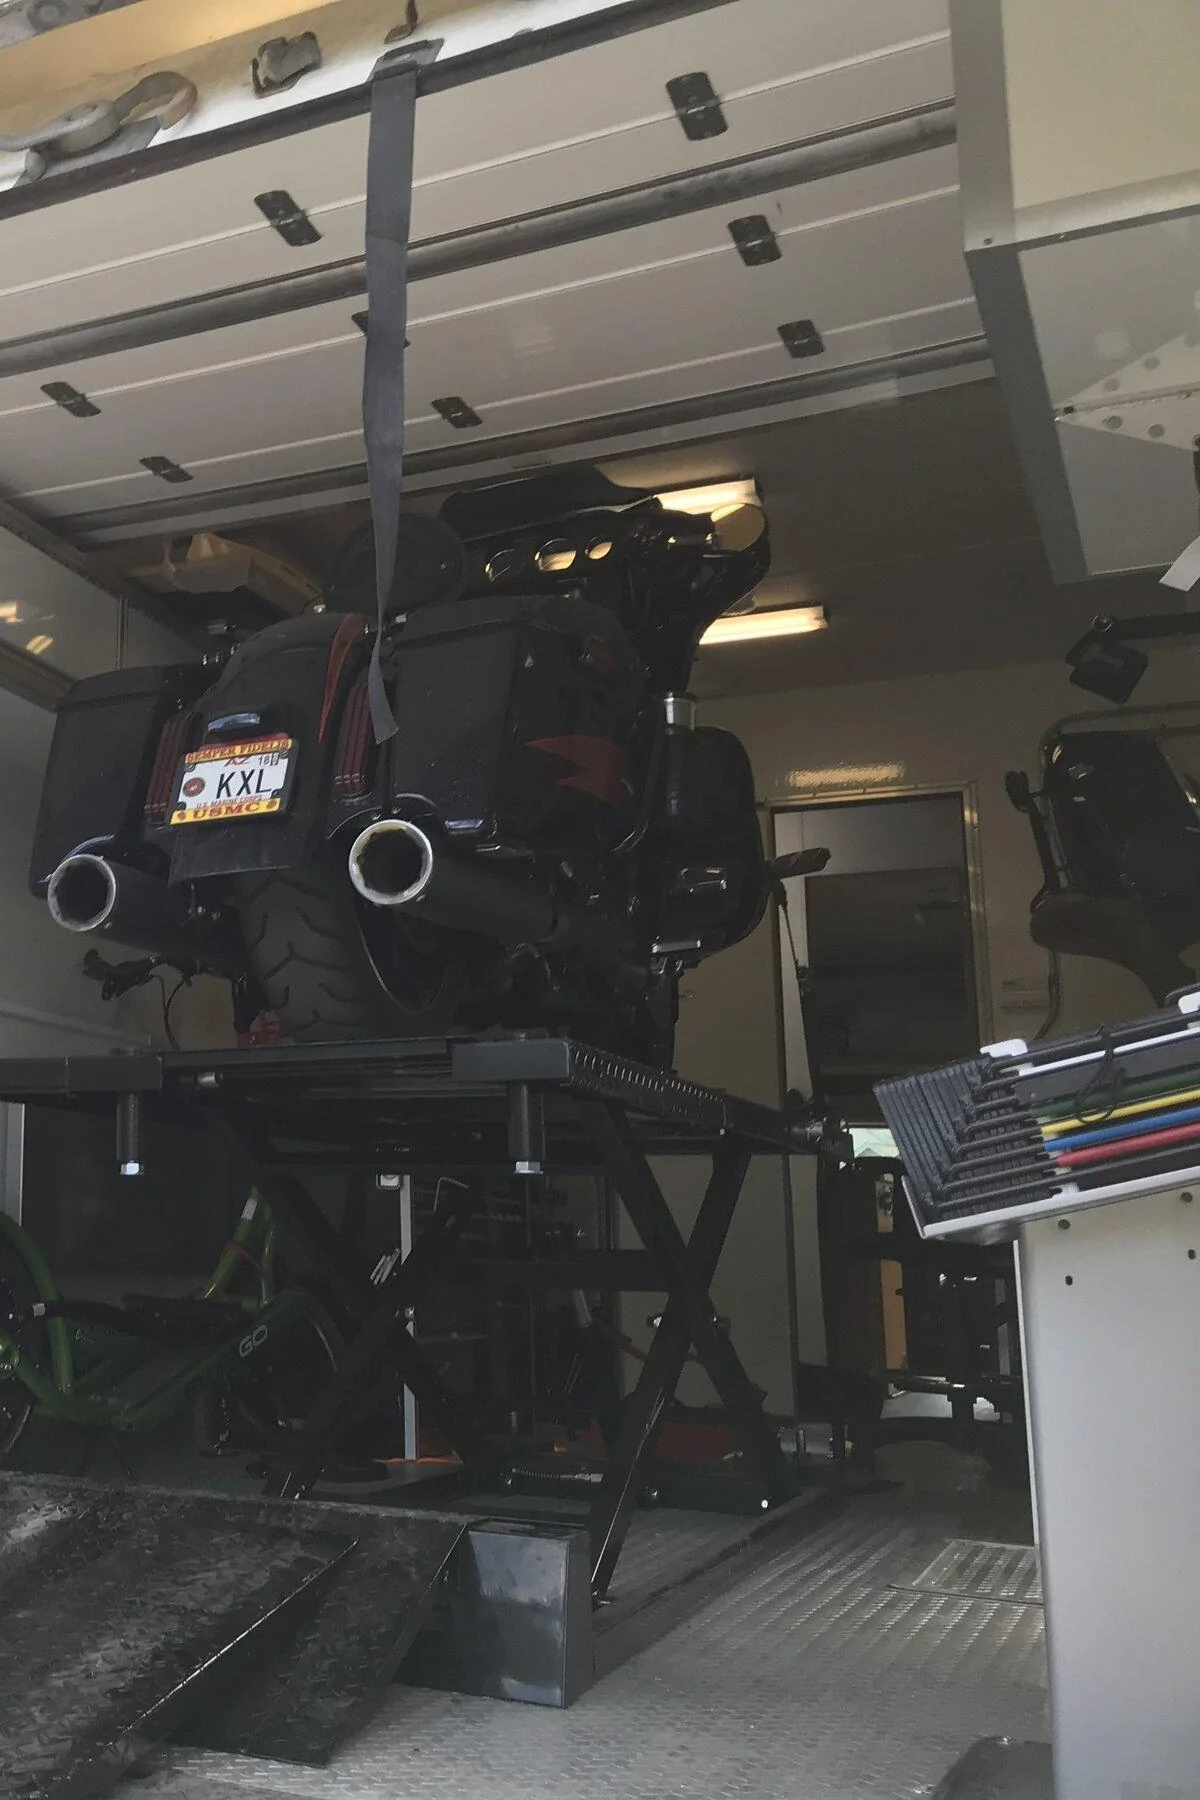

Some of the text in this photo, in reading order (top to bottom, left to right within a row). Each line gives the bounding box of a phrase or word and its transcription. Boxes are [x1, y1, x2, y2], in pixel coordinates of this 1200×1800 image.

[216, 768, 272, 799] KXL
[194, 803, 259, 818] USMC
[238, 1324, 269, 1358] GO
